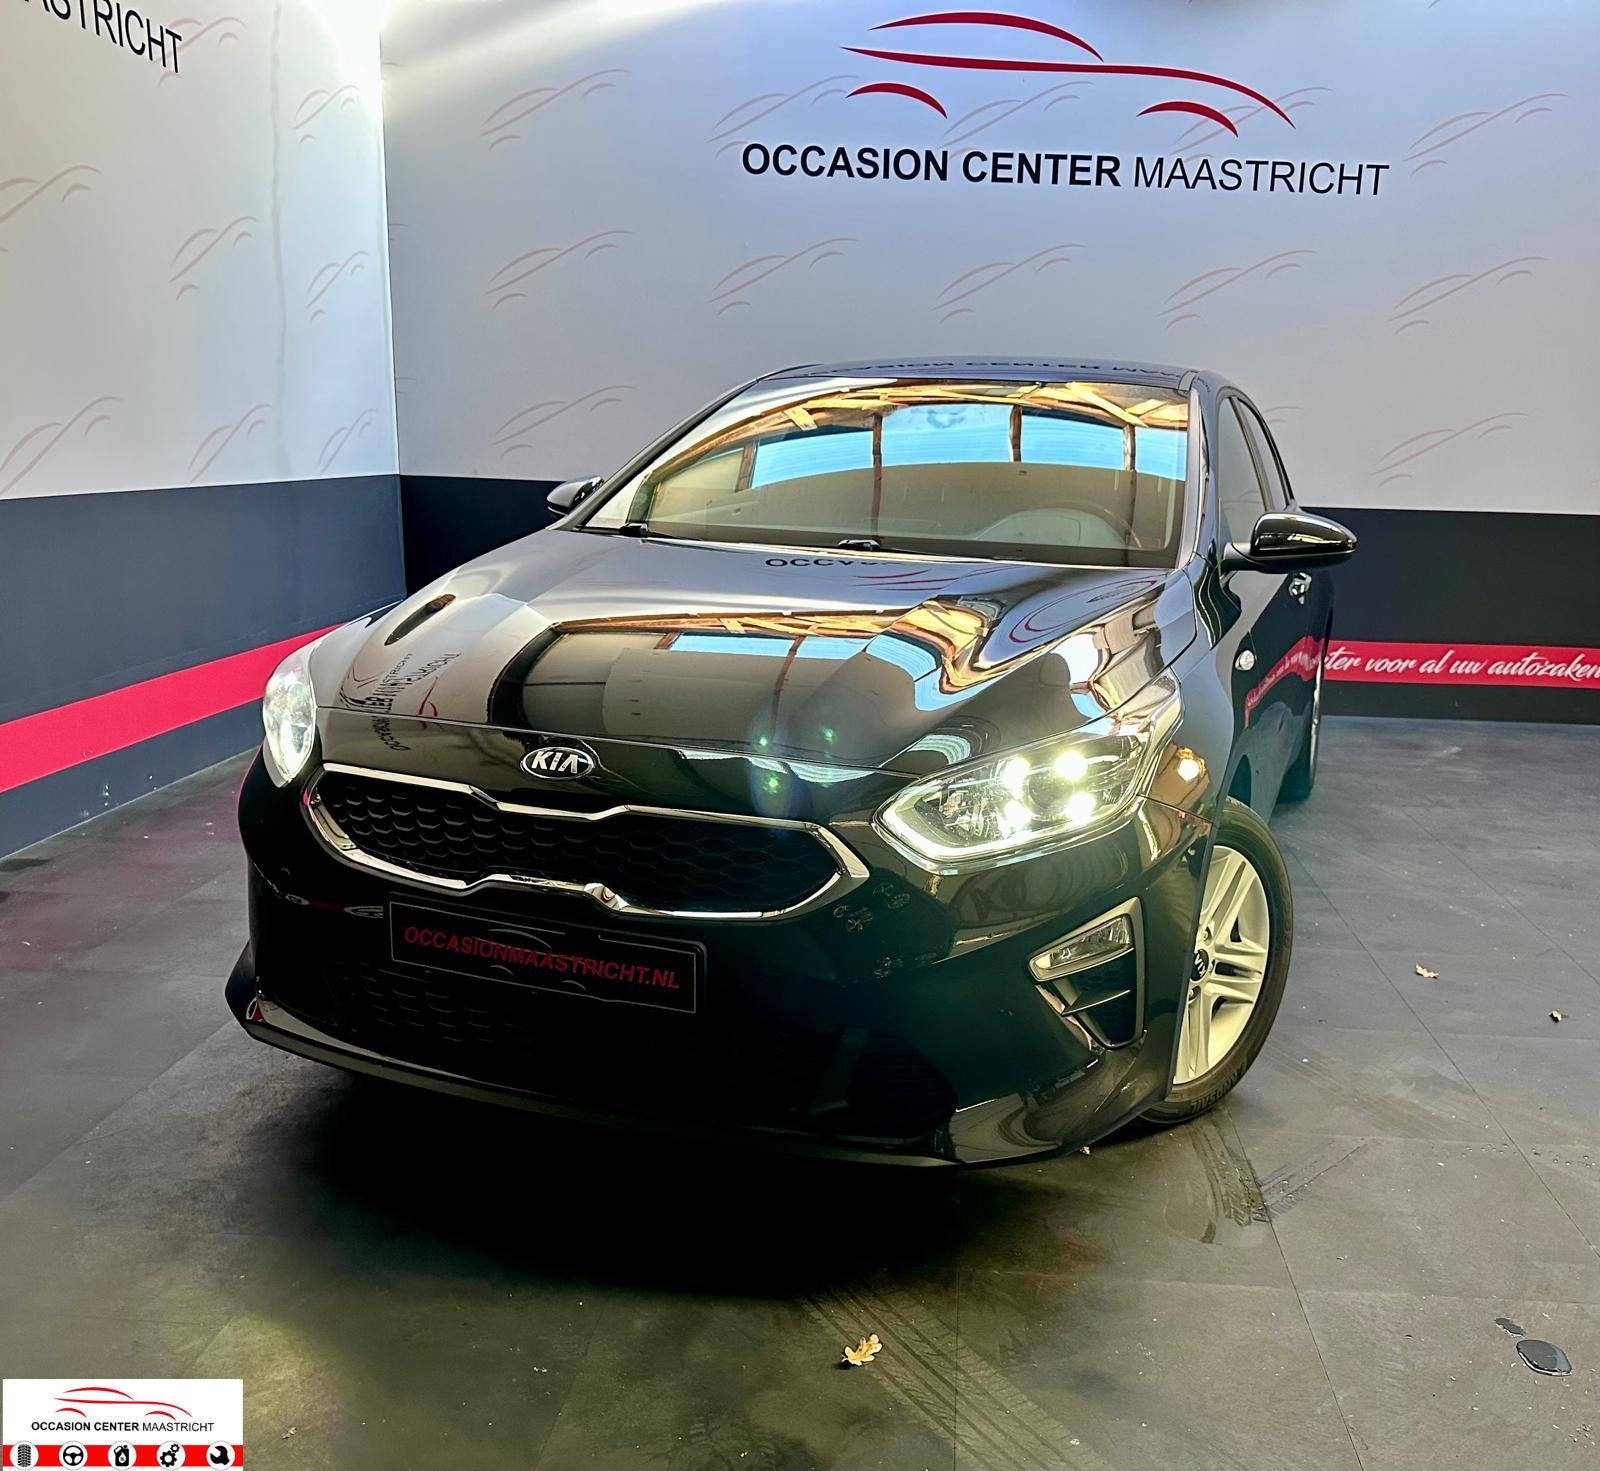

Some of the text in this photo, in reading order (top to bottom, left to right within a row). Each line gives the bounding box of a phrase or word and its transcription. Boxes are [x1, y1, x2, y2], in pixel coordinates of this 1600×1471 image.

[742, 143, 1390, 196] OCCASION CENTER MAASTRICHT
[1365, 657, 1416, 673] voor
[1419, 650, 1454, 674] al
[1449, 660, 1486, 674] uw
[1487, 652, 1600, 681] autozaken
[533, 750, 580, 772] KIA
[404, 926, 680, 989] OCCASIONMAASTRICHT.NL
[1194, 953, 1207, 977] KIA
